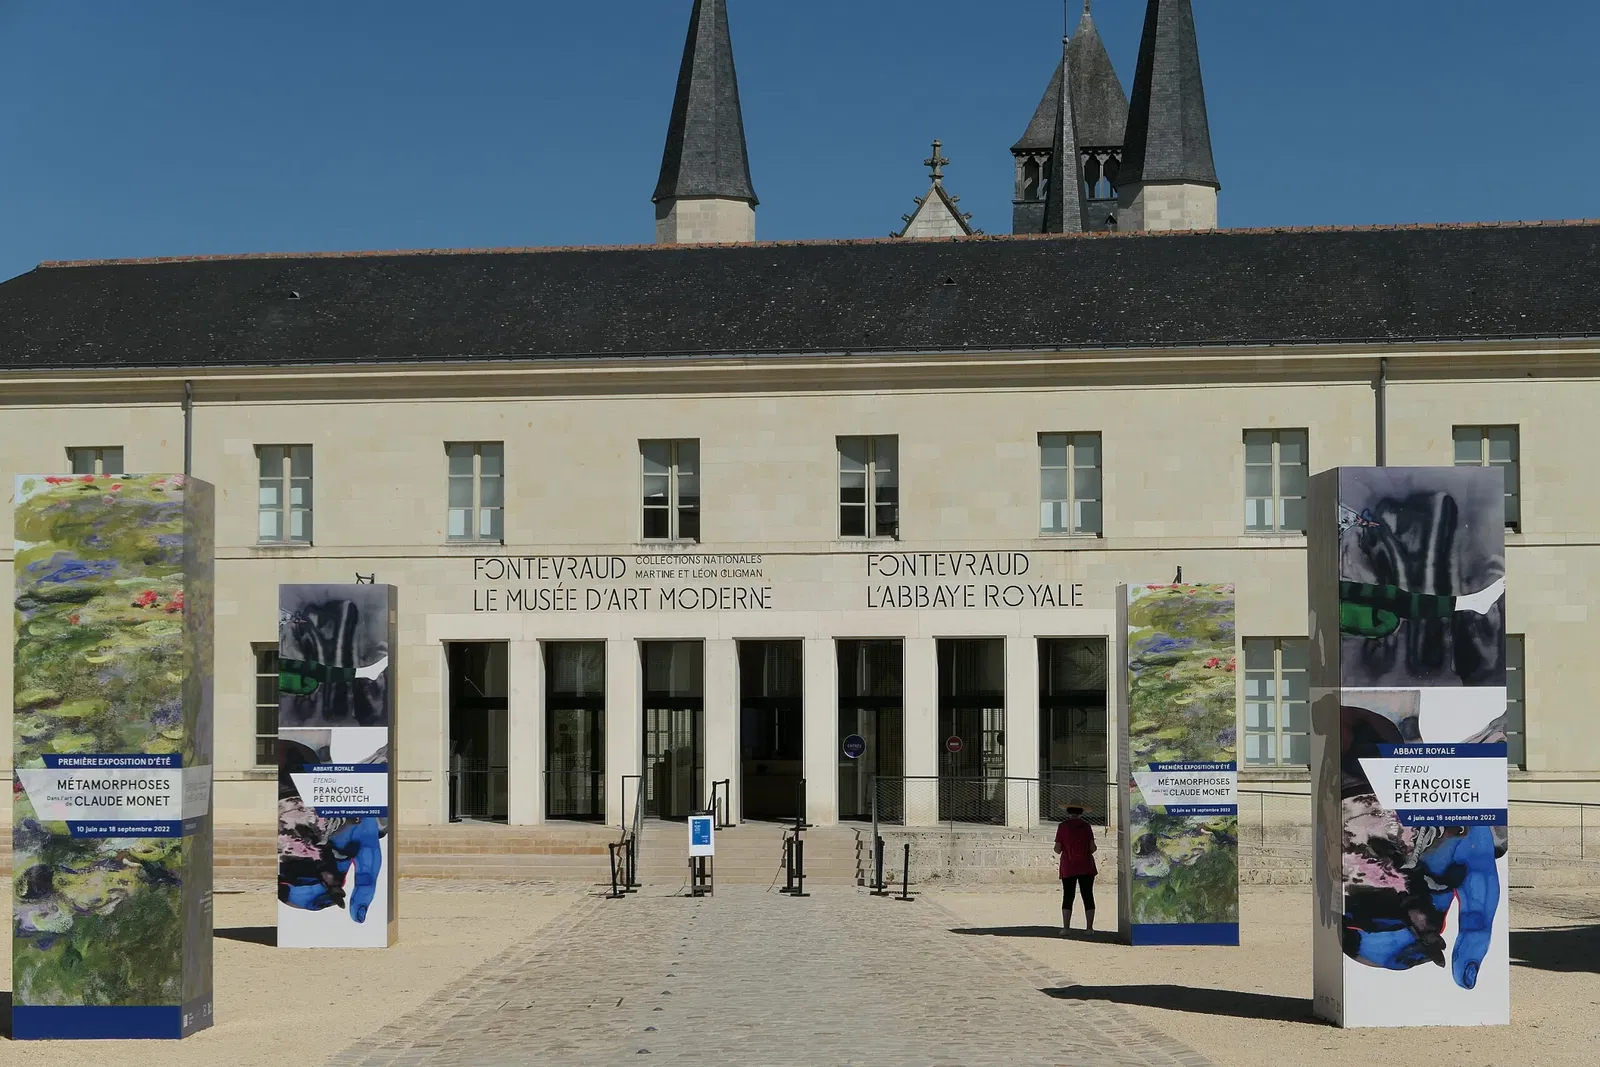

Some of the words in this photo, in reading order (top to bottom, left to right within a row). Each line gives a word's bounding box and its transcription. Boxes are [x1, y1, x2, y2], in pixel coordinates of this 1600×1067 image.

[635, 555, 700, 565] COLLECTIONS
[703, 555, 762, 564] NATIONALES
[867, 553, 1030, 577] FONTEVRAUD
[474, 557, 626, 580] FONTEVRAUD
[635, 570, 675, 579] MARTINE
[678, 569, 690, 578] ET
[692, 568, 718, 578] LÉON
[720, 569, 763, 578] CLIGMAN
[474, 589, 497, 611] LE
[506, 581, 577, 611] MUSÉE
[586, 588, 652, 611] D'ART
[660, 587, 772, 610] MODERNE
[867, 585, 975, 608] L'ABBAYE
[985, 584, 1083, 607] ROYALE
[1393, 747, 1424, 755] ABBAYE
[1425, 747, 1456, 755] ROYALE
[58, 756, 97, 766] PREMIÈRE
[98, 757, 147, 766] EXPOSITION
[148, 757, 171, 766] D'ÉTÉ
[1393, 764, 1430, 774] ÉTENDU
[57, 776, 170, 790] MÉTAMORPHOSES
[1158, 776, 1230, 786] MÉTAMORPHOSES
[1394, 779, 1471, 793] FRANÇOISE
[313, 786, 364, 796] FRANÇOISE
[1169, 788, 1201, 796] CLAUDE
[1202, 788, 1230, 796] MONET
[74, 796, 123, 806] CLAUDE
[126, 796, 170, 806] MONET
[1413, 814, 1425, 822] juin
[1445, 814, 1479, 822] septembre
[85, 825, 98, 834] juin
[117, 826, 152, 834] septembre
